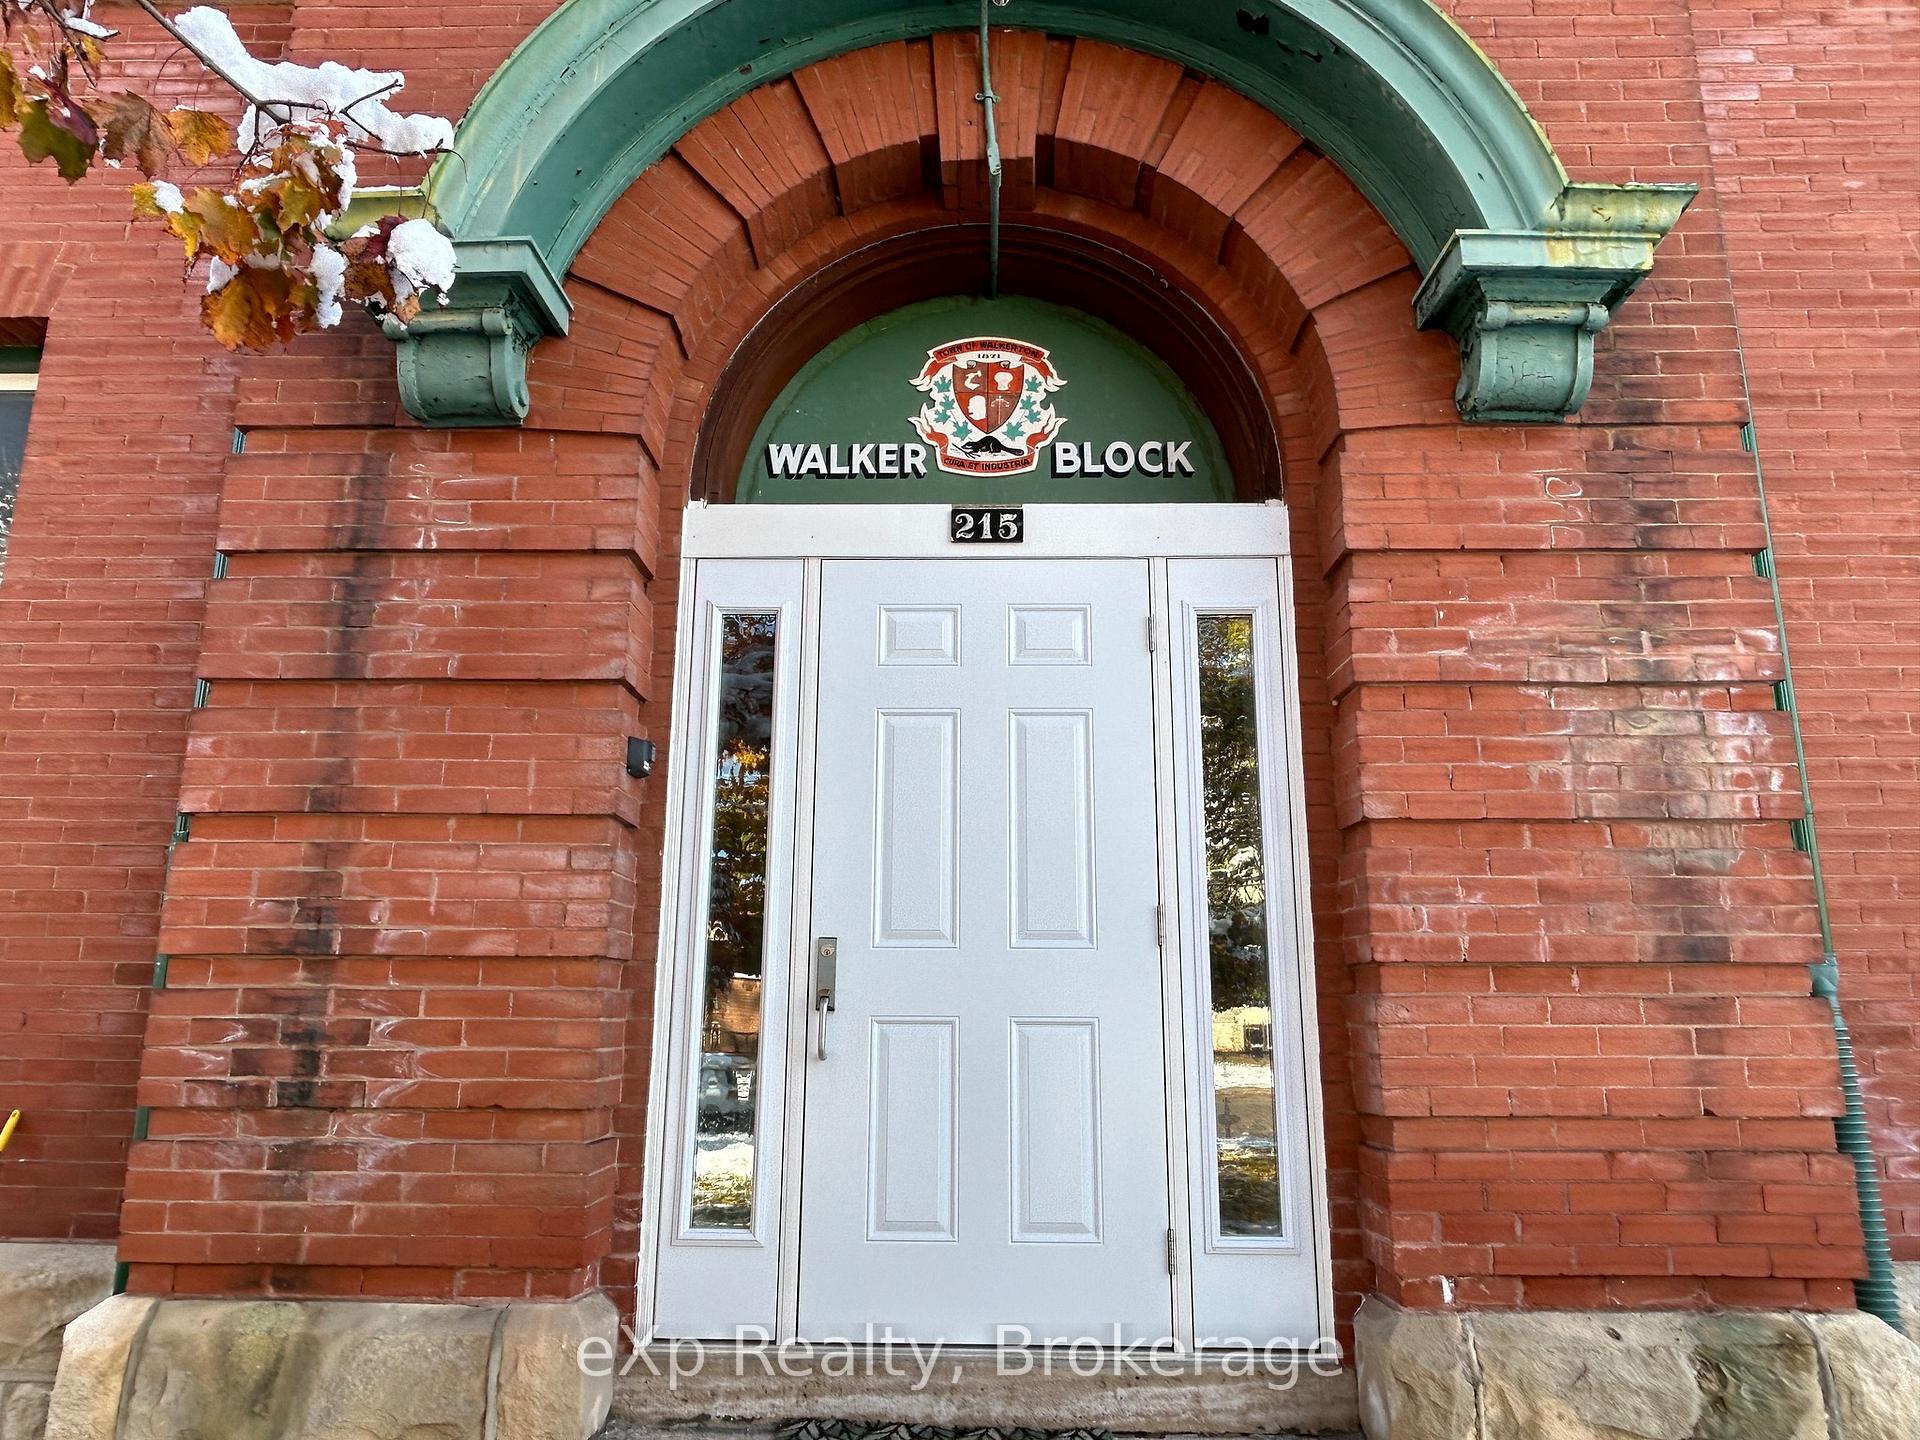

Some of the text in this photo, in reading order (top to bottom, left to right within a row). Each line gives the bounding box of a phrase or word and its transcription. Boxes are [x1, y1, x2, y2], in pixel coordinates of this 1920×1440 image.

[939, 341, 1039, 358] TOWN OF WALKERTON
[767, 441, 1195, 479] WALKER BLOCK
[943, 457, 1031, 471] CURA ET INDUSTRIA
[954, 512, 1018, 540] 215
